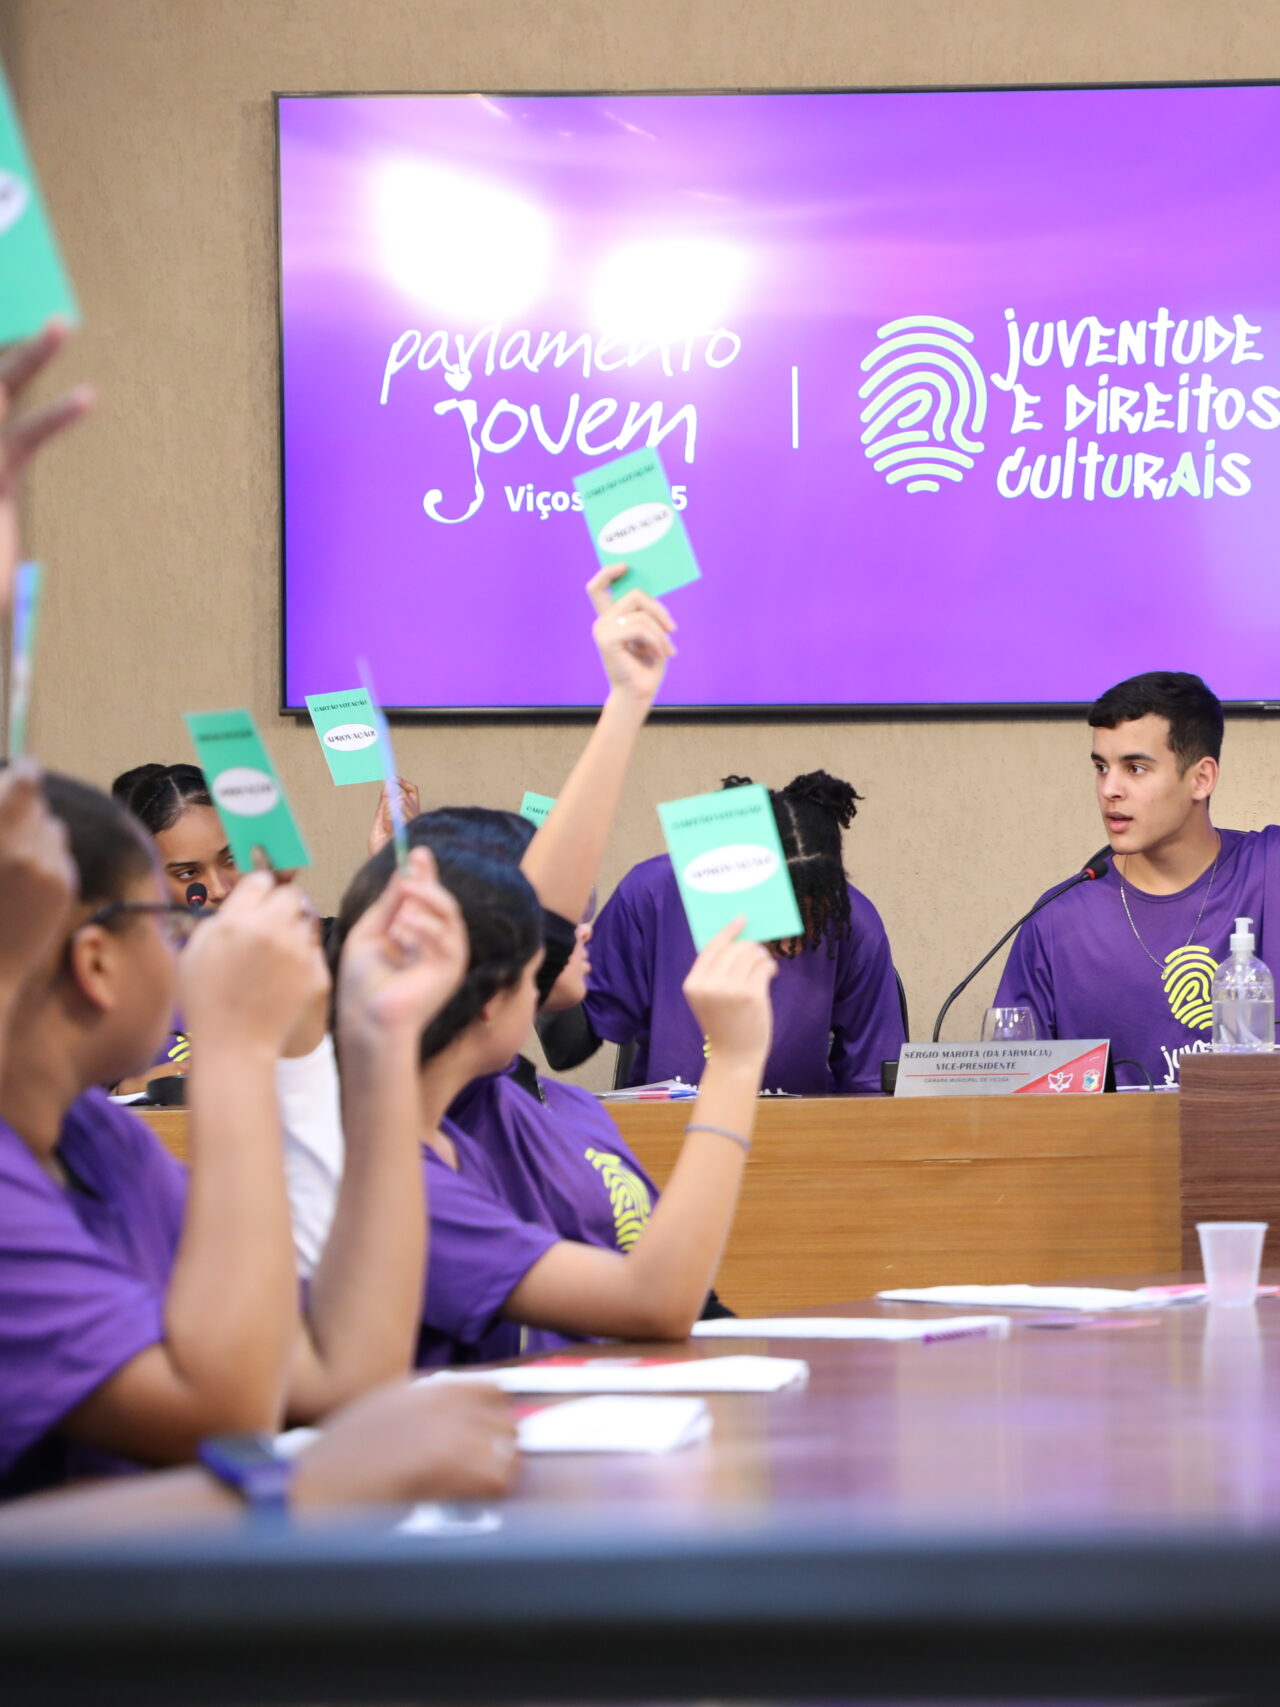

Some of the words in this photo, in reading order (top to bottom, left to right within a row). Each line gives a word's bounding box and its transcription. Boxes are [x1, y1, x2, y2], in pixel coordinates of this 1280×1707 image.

[1010, 383, 1043, 434] E
[423, 393, 698, 524] jovem
[504, 484, 585, 520] Viços
[936, 1061, 1017, 1071] VICE-PRESIDENTE
[941, 1050, 979, 1059] MAROTA
[982, 1049, 1000, 1059] (DA
